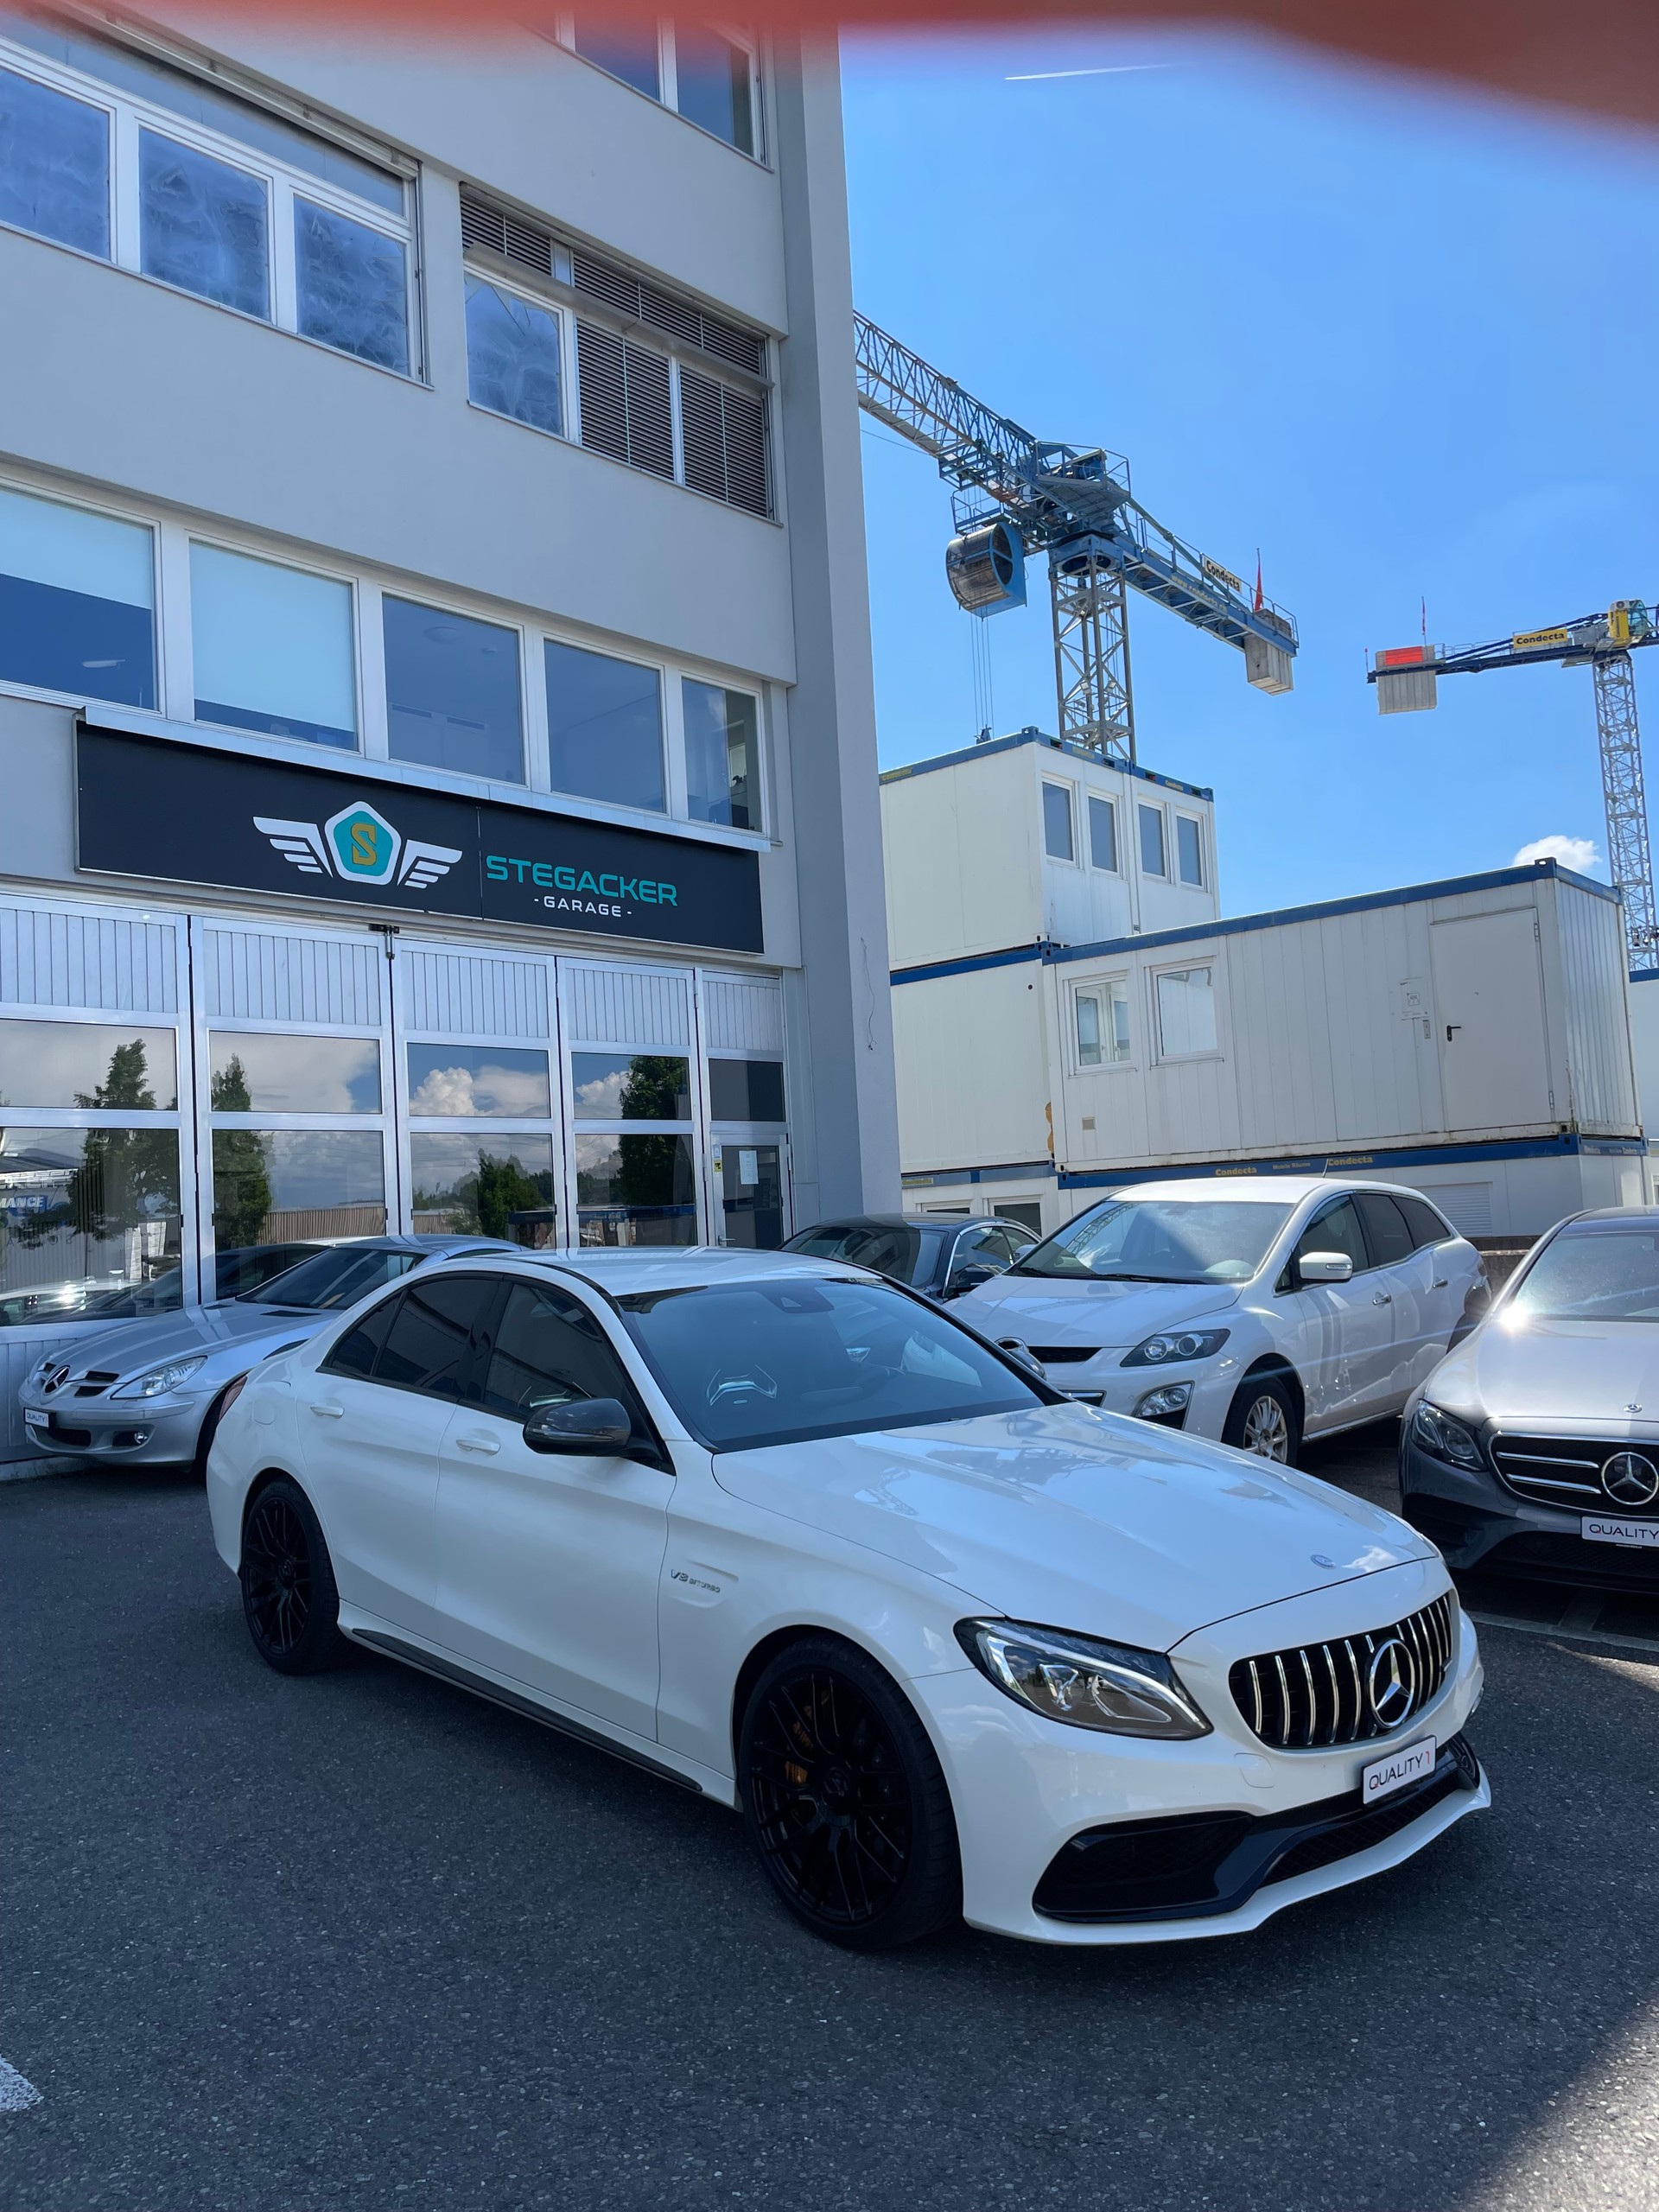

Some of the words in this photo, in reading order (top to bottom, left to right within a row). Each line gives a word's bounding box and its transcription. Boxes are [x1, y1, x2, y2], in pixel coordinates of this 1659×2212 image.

[1206, 560, 1240, 592] Condecta
[1516, 632, 1565, 645] Condecta
[351, 823, 378, 866] S
[486, 855, 678, 906] STEGACKER
[1215, 1166, 1257, 1176] Condecta
[1328, 1156, 1374, 1166] Condecta
[1589, 1523, 1659, 1540] QUALITY
[671, 1569, 689, 1582] V8
[1369, 1752, 1423, 1790] QUALITY
